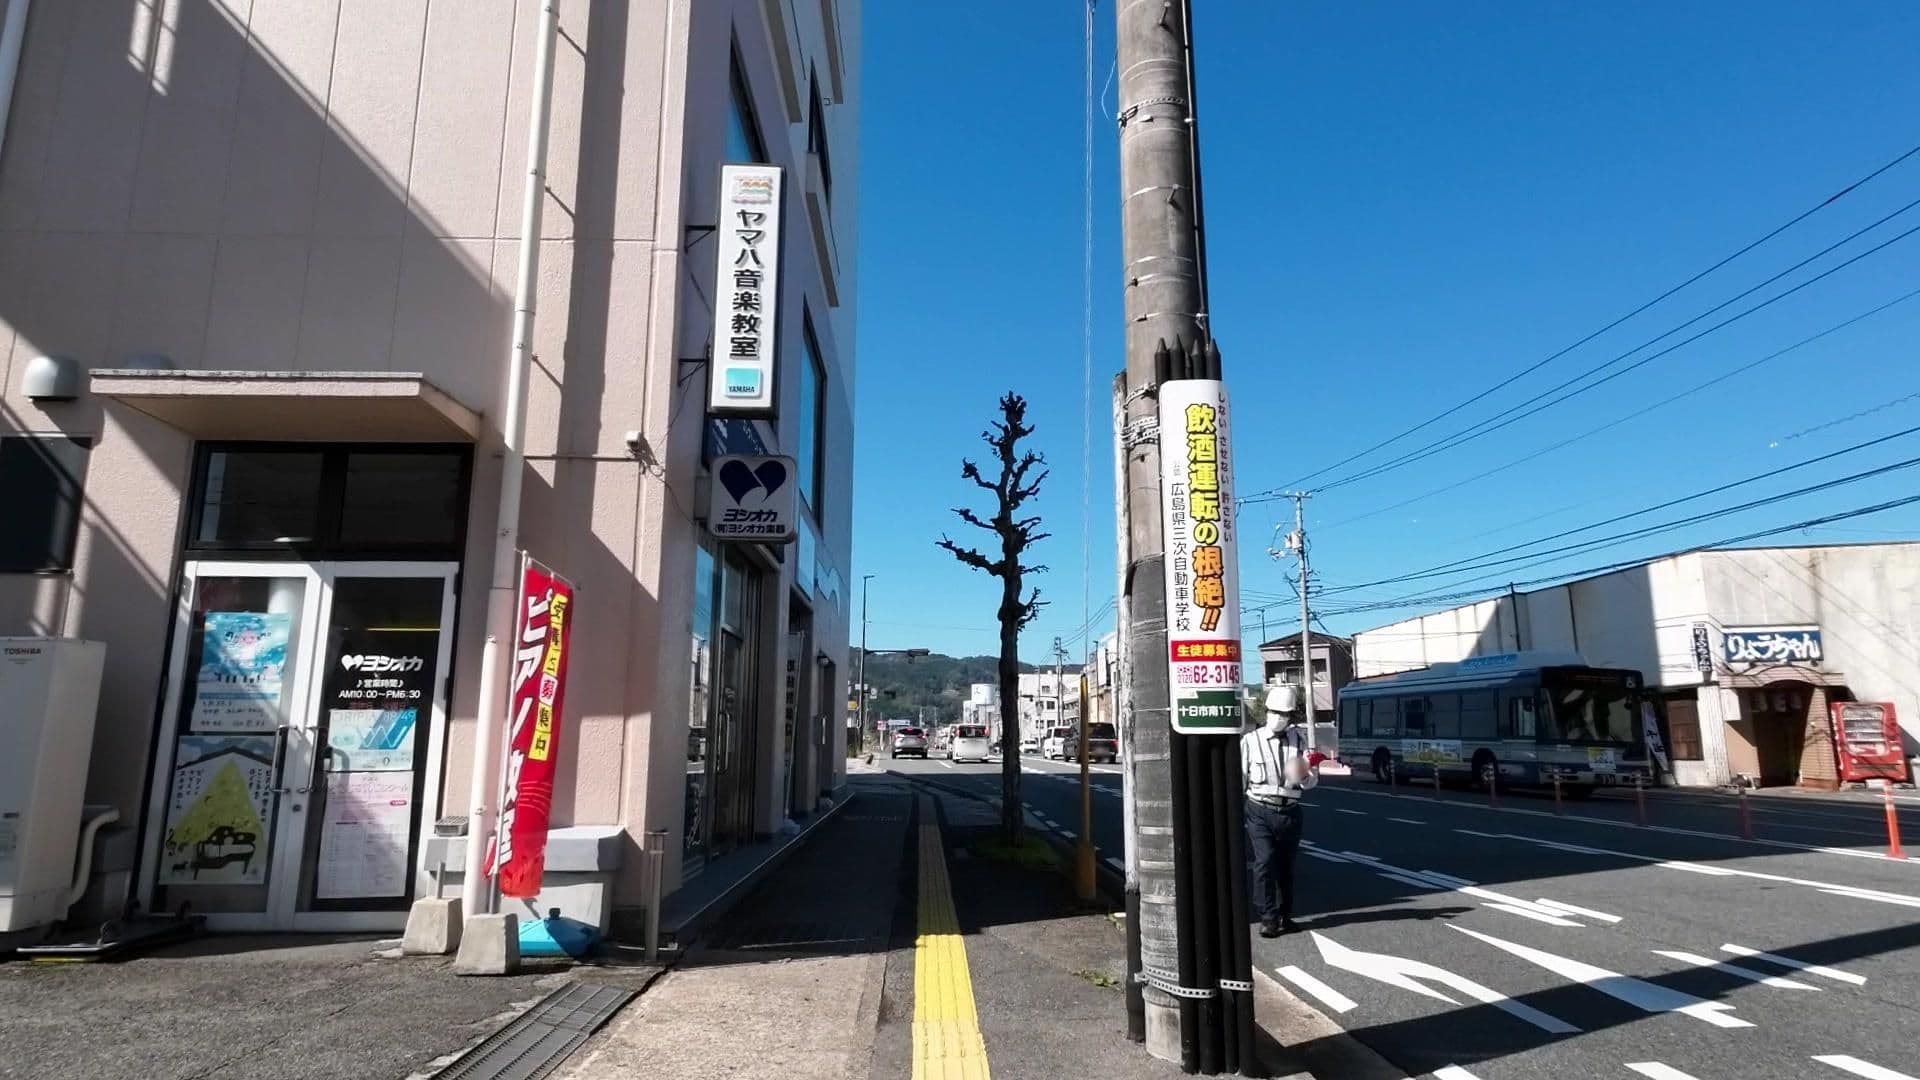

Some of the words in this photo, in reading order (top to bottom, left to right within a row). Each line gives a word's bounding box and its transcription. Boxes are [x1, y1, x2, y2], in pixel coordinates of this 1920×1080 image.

[729, 209, 763, 358] ヤマハ音楽教室
[728, 385, 755, 393] YAMAHA
[1218, 392, 1227, 428] しない
[1220, 437, 1230, 485] させない
[723, 509, 778, 522] ヨシオカ
[1171, 483, 1191, 632] 広島県三次自動車学校
[4, 647, 41, 655] TOSHIBA
[1177, 643, 1238, 658] 生徒募集中
[360, 655, 424, 672] ヨシオカ
[1193, 665, 1240, 684] 62-3145
